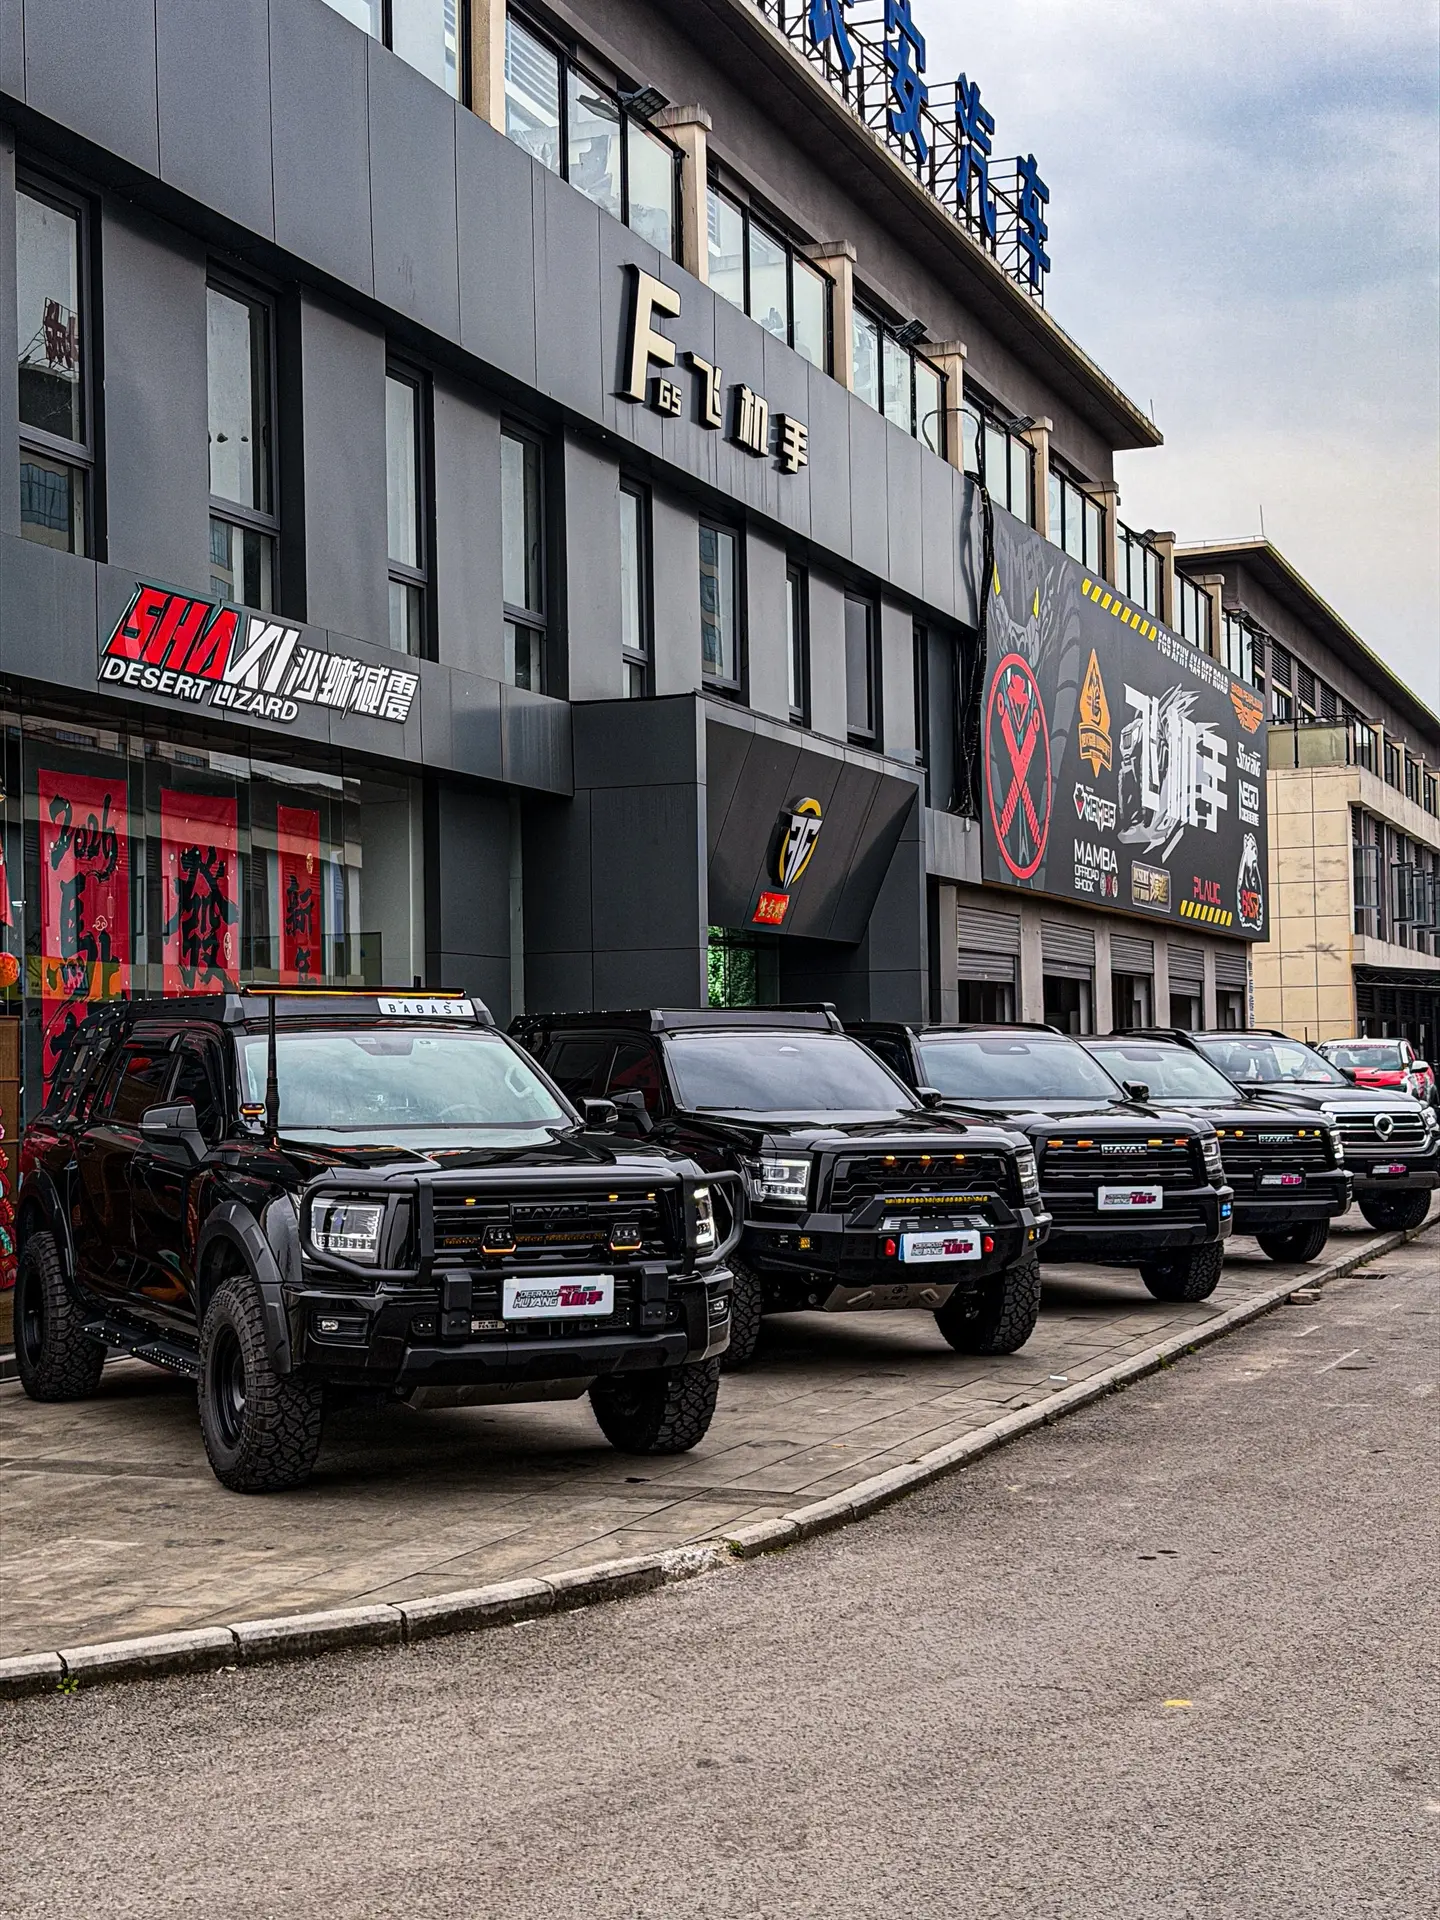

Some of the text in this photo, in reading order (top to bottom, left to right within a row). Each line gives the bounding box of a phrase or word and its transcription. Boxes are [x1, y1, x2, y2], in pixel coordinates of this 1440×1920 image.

[688, 351, 809, 475] 飞机手
[101, 656, 299, 722] DESERT LIZARD
[1074, 838, 1119, 874] MAMBA
[1074, 864, 1100, 882] OFFROAD
[1074, 877, 1095, 893] SHOCK
[1104, 1145, 1146, 1154] HAVAL
[515, 1206, 588, 1219] HAVAL
[512, 1297, 558, 1309] HUYANG
